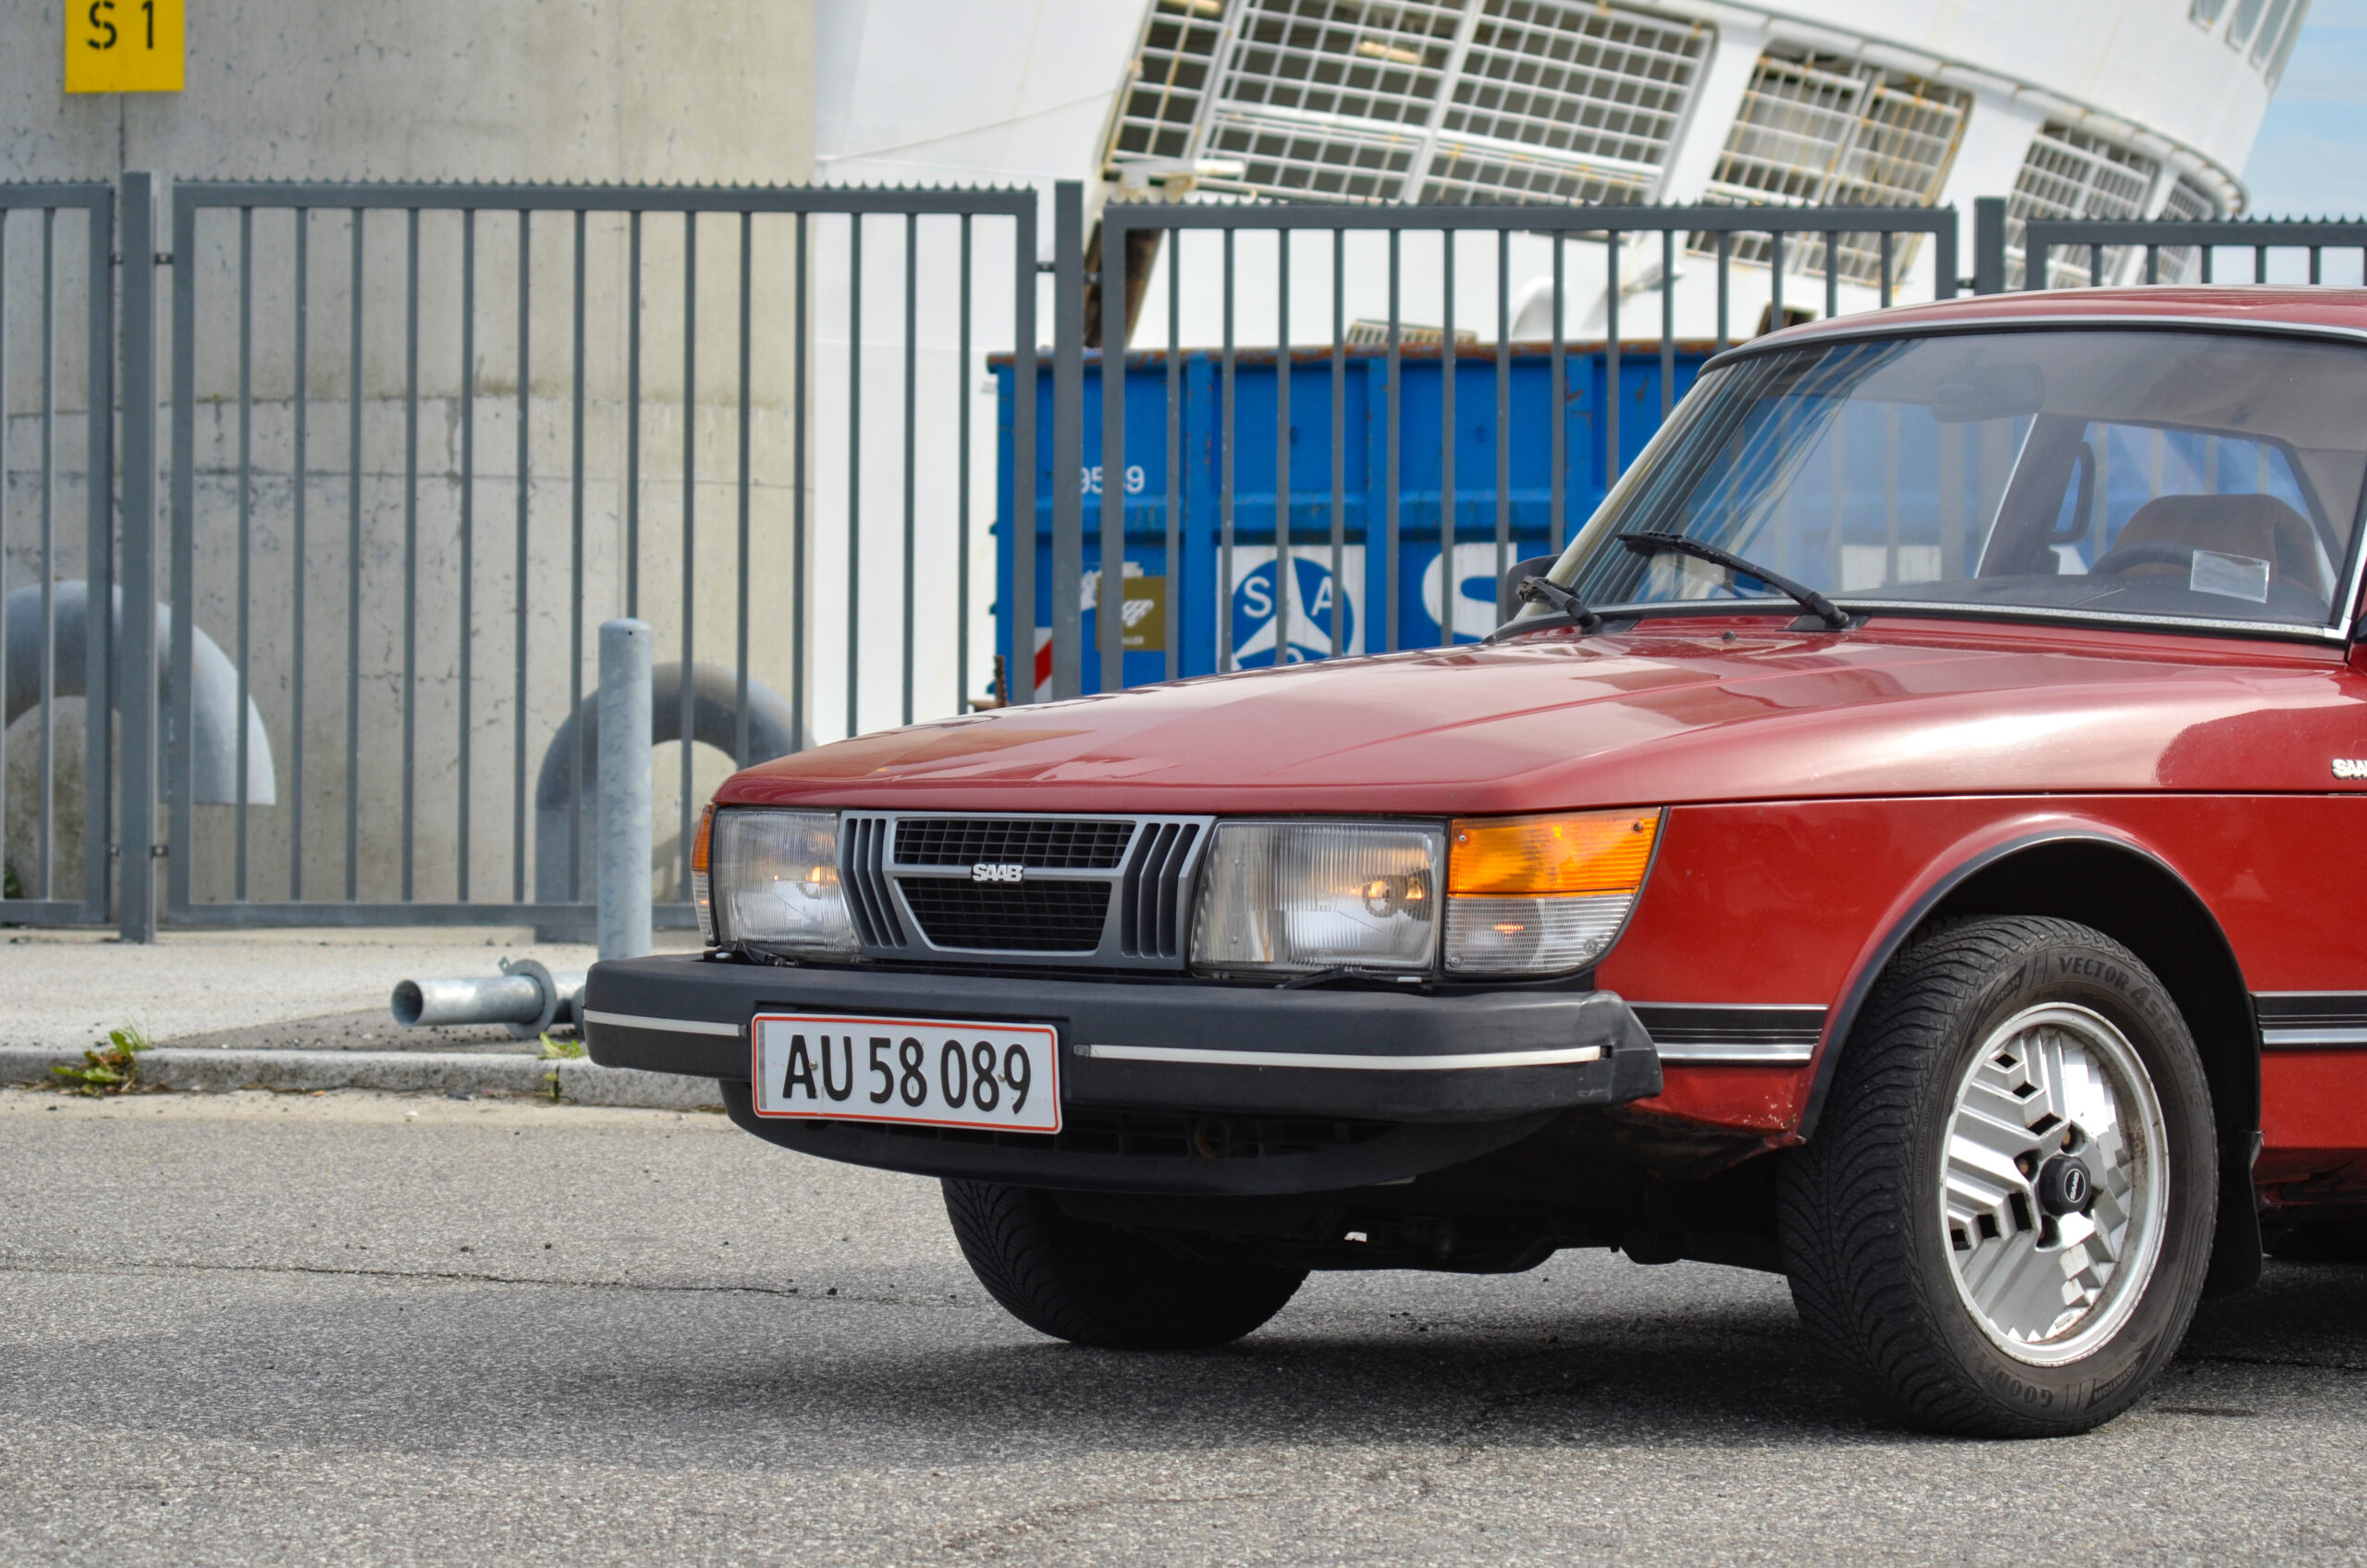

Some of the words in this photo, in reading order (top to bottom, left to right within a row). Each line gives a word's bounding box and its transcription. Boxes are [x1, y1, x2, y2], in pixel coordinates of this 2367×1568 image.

[87, 0, 117, 49] S
[141, 0, 153, 49] 1
[1244, 575, 1272, 619] S
[2331, 758, 2367, 779] SAA
[972, 864, 1024, 882] SAAB
[2059, 957, 2130, 991] VECTOR
[782, 1035, 853, 1101] AU
[869, 1036, 927, 1107] 58
[940, 1039, 1031, 1115] 089
[2092, 1362, 2139, 1402] ROTATION
